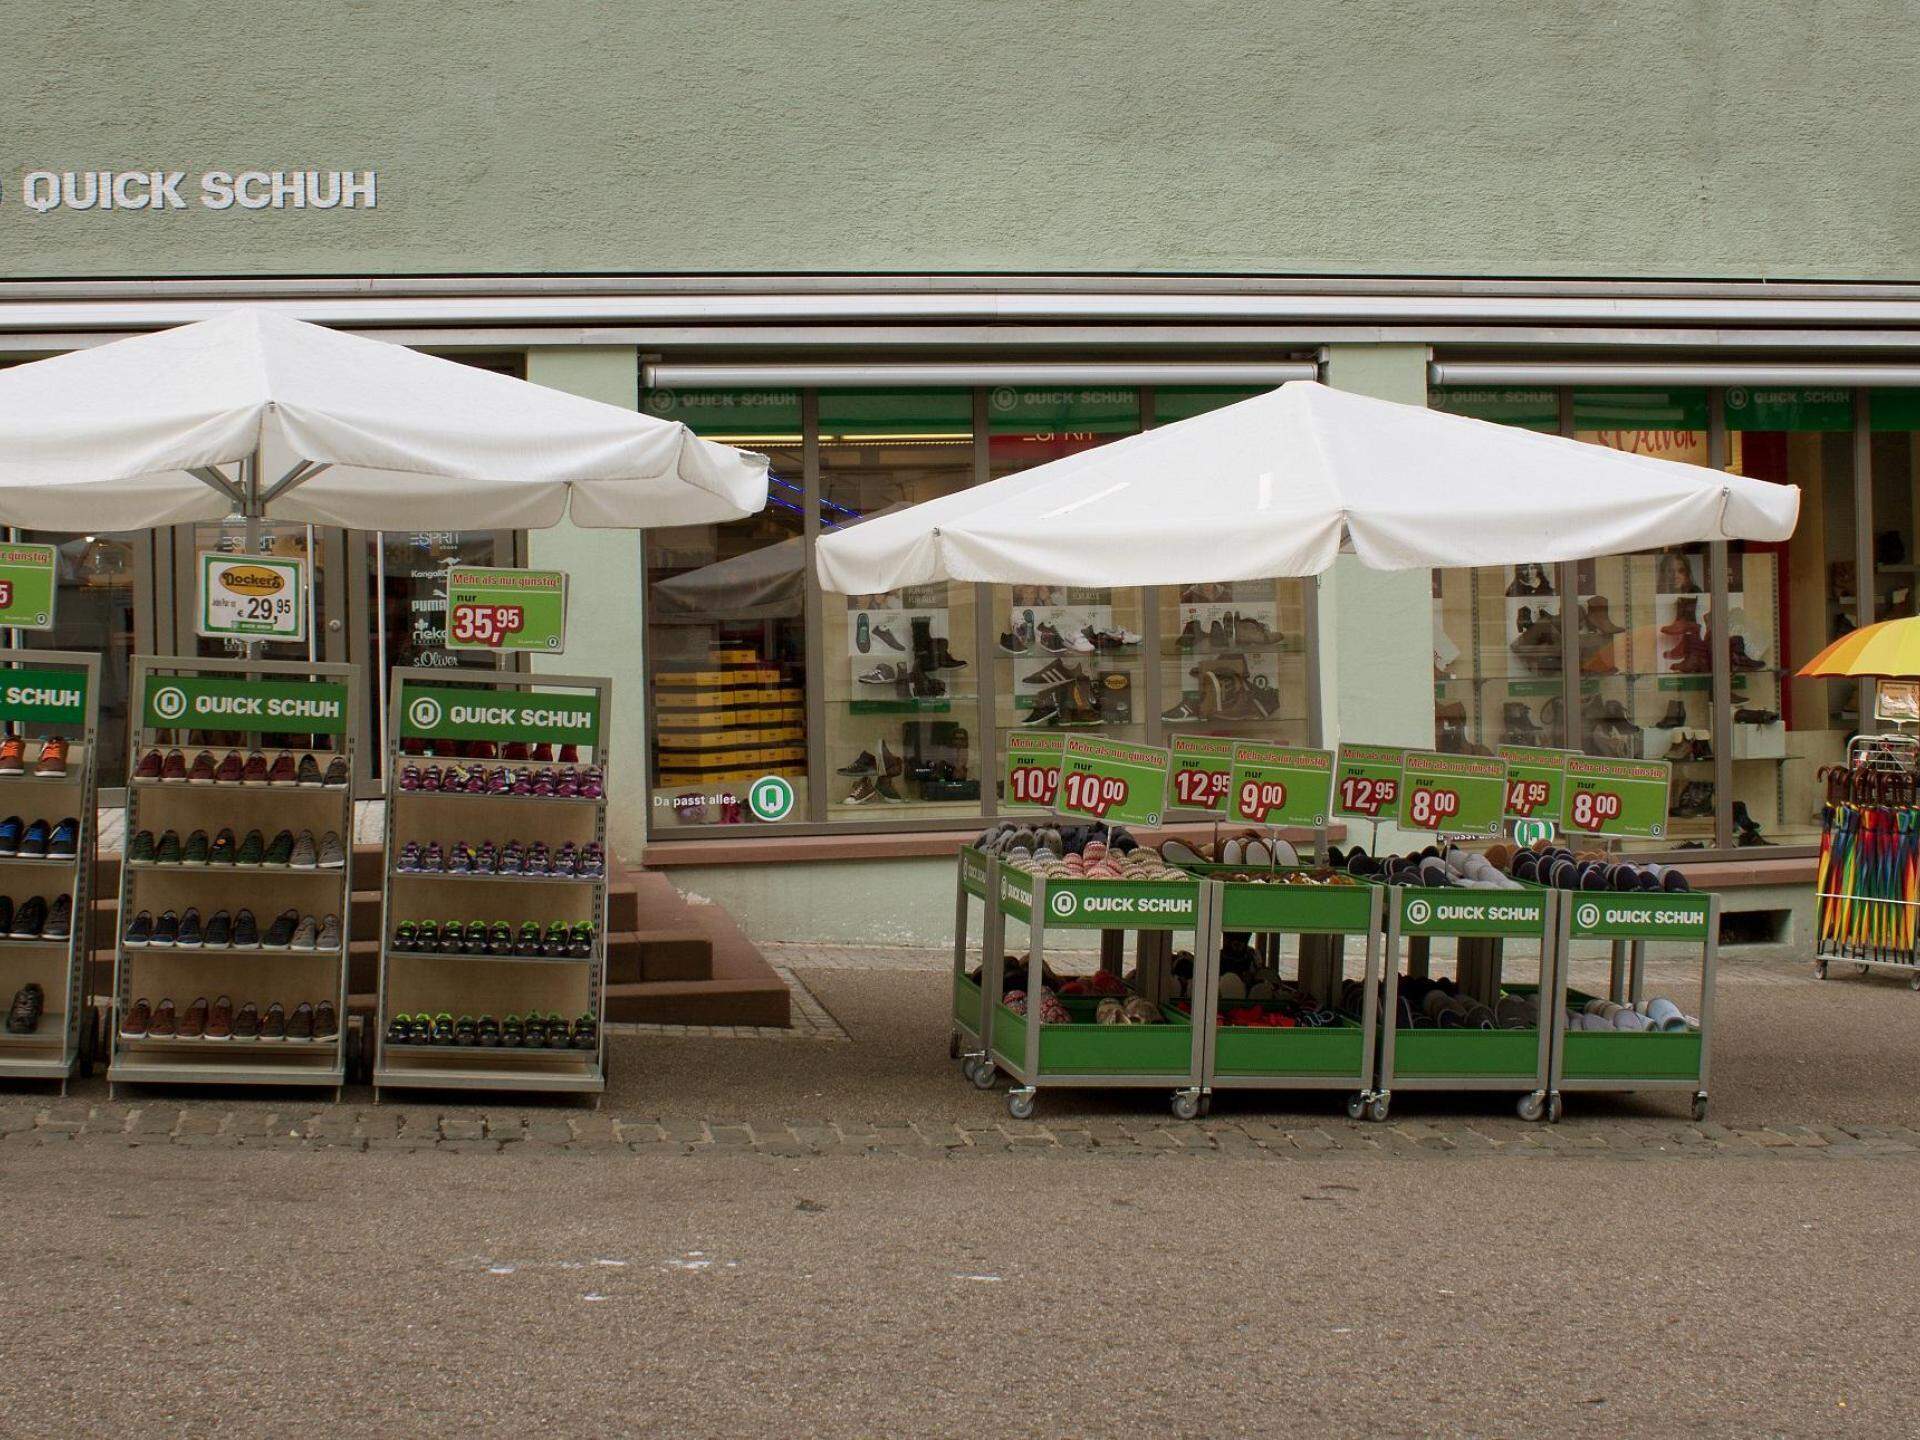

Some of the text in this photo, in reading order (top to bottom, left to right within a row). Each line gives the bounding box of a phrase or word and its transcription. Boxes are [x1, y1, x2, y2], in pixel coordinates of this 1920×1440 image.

[23, 171, 377, 213] QUICK SCHUH
[457, 594, 477, 602] nur
[247, 597, 291, 625] 29,95
[455, 607, 520, 643] 35,95
[6, 686, 81, 707] SCHUH
[196, 695, 264, 715] QUICK
[267, 698, 340, 718] SCHUH
[450, 706, 517, 725] QUICK
[520, 709, 592, 729] SCHUH
[1017, 757, 1035, 765] nur
[1073, 762, 1093, 772] nur
[1182, 759, 1200, 768] nur
[1348, 767, 1366, 776] nur
[1013, 768, 1059, 801] 10,0
[1244, 769, 1263, 779] nur
[1416, 777, 1434, 787] nur
[1068, 775, 1125, 814] 10,00
[1177, 771, 1231, 805] 12,95
[1342, 779, 1395, 812] 12,95
[1577, 781, 1596, 790] nur
[653, 796, 670, 807] Da
[673, 795, 706, 809] passt
[708, 794, 741, 805] alles.
[1241, 783, 1283, 818] 9,00
[1413, 791, 1455, 826] 8,00
[1504, 782, 1546, 814] 4,95
[1575, 794, 1617, 828] 8,00
[1083, 897, 1135, 912] QUICK
[1137, 898, 1193, 913] SCHUH
[1437, 905, 1485, 920] QUICK
[1488, 906, 1540, 921] SCHUH
[1605, 909, 1652, 924] QUICK
[1655, 910, 1704, 925] SCHUH
